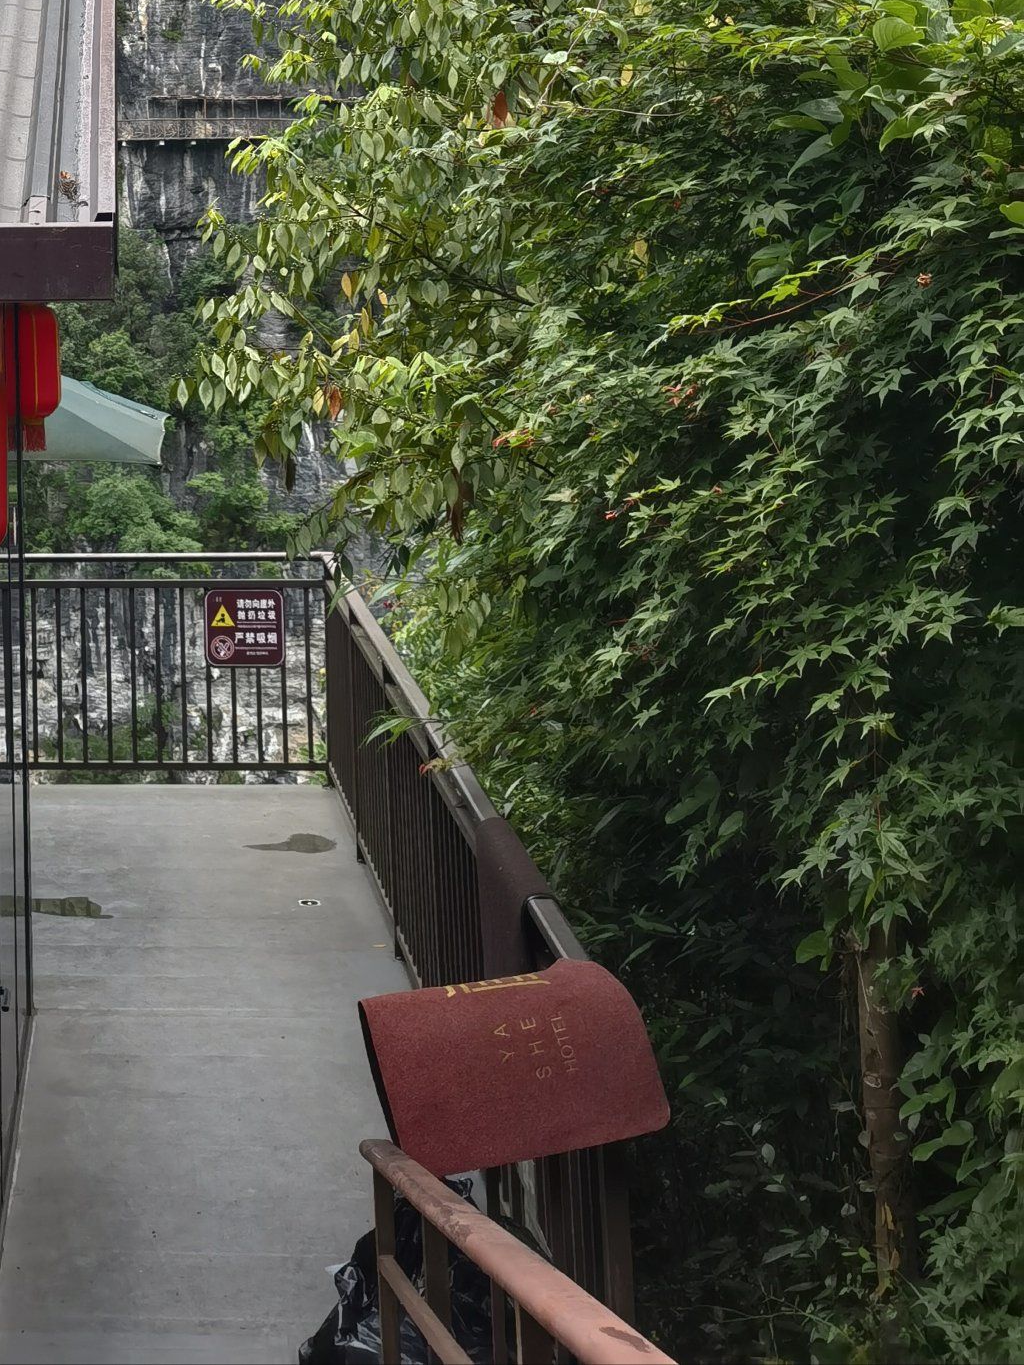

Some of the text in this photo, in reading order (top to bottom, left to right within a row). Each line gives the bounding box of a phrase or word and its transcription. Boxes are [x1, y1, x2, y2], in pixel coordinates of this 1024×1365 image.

[234, 632, 277, 644] 严禁吸烟
[550, 1011, 579, 1073] HOTEL
